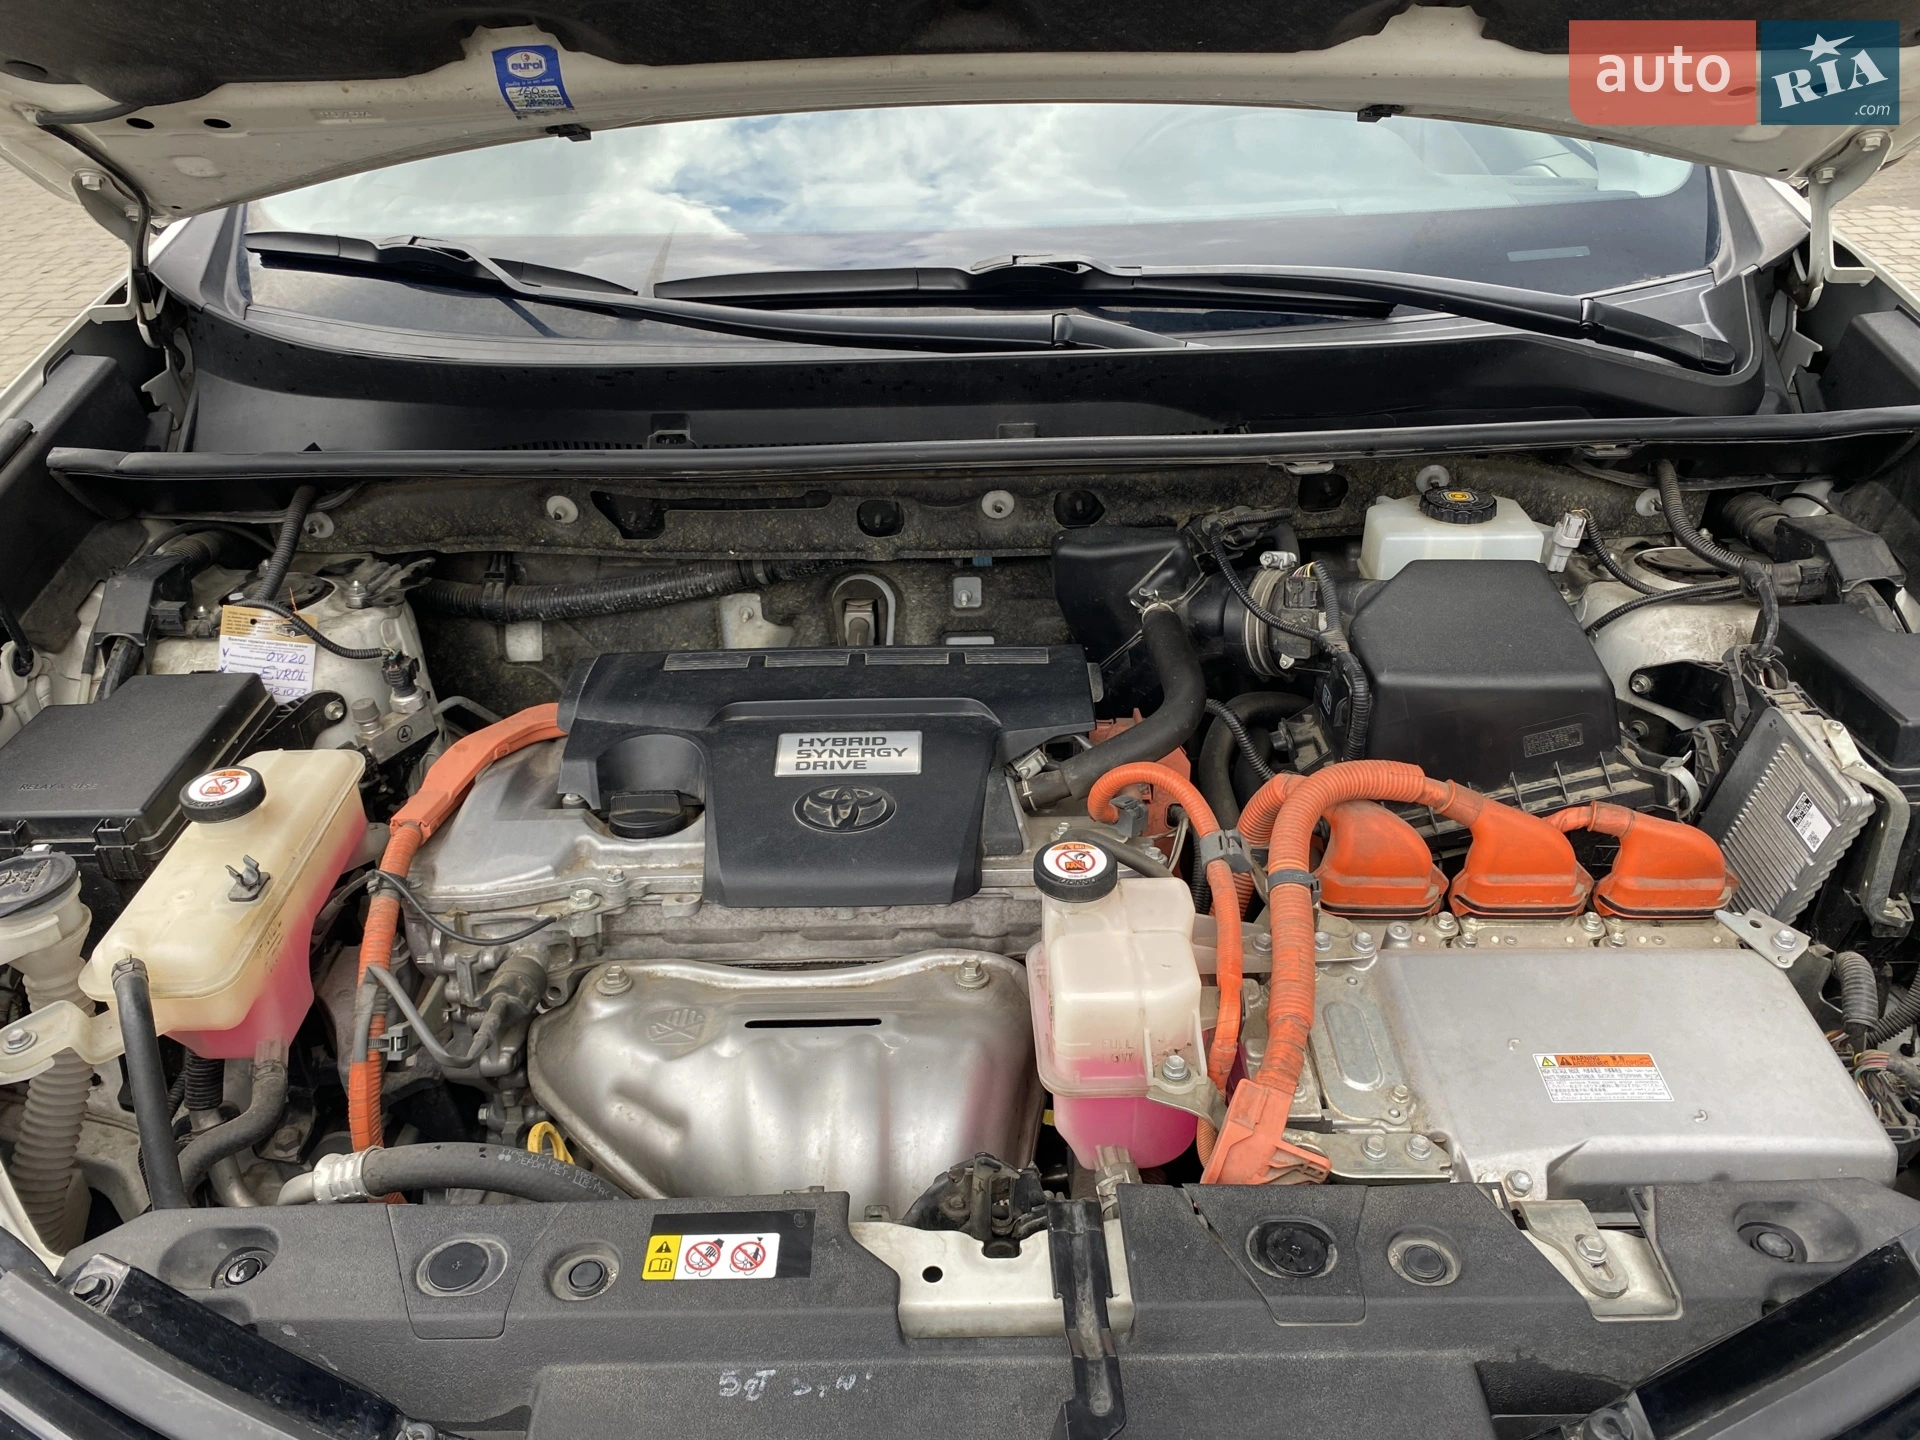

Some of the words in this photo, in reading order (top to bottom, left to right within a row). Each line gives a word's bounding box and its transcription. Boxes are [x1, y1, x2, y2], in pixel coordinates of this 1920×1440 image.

[511, 60, 543, 71] eurol
[798, 737, 887, 747] HYBRID
[796, 747, 908, 759] SYNERGY
[795, 760, 867, 770] DRIVE
[19, 783, 57, 791] RELAY
[1058, 878, 1097, 886] DENSO
